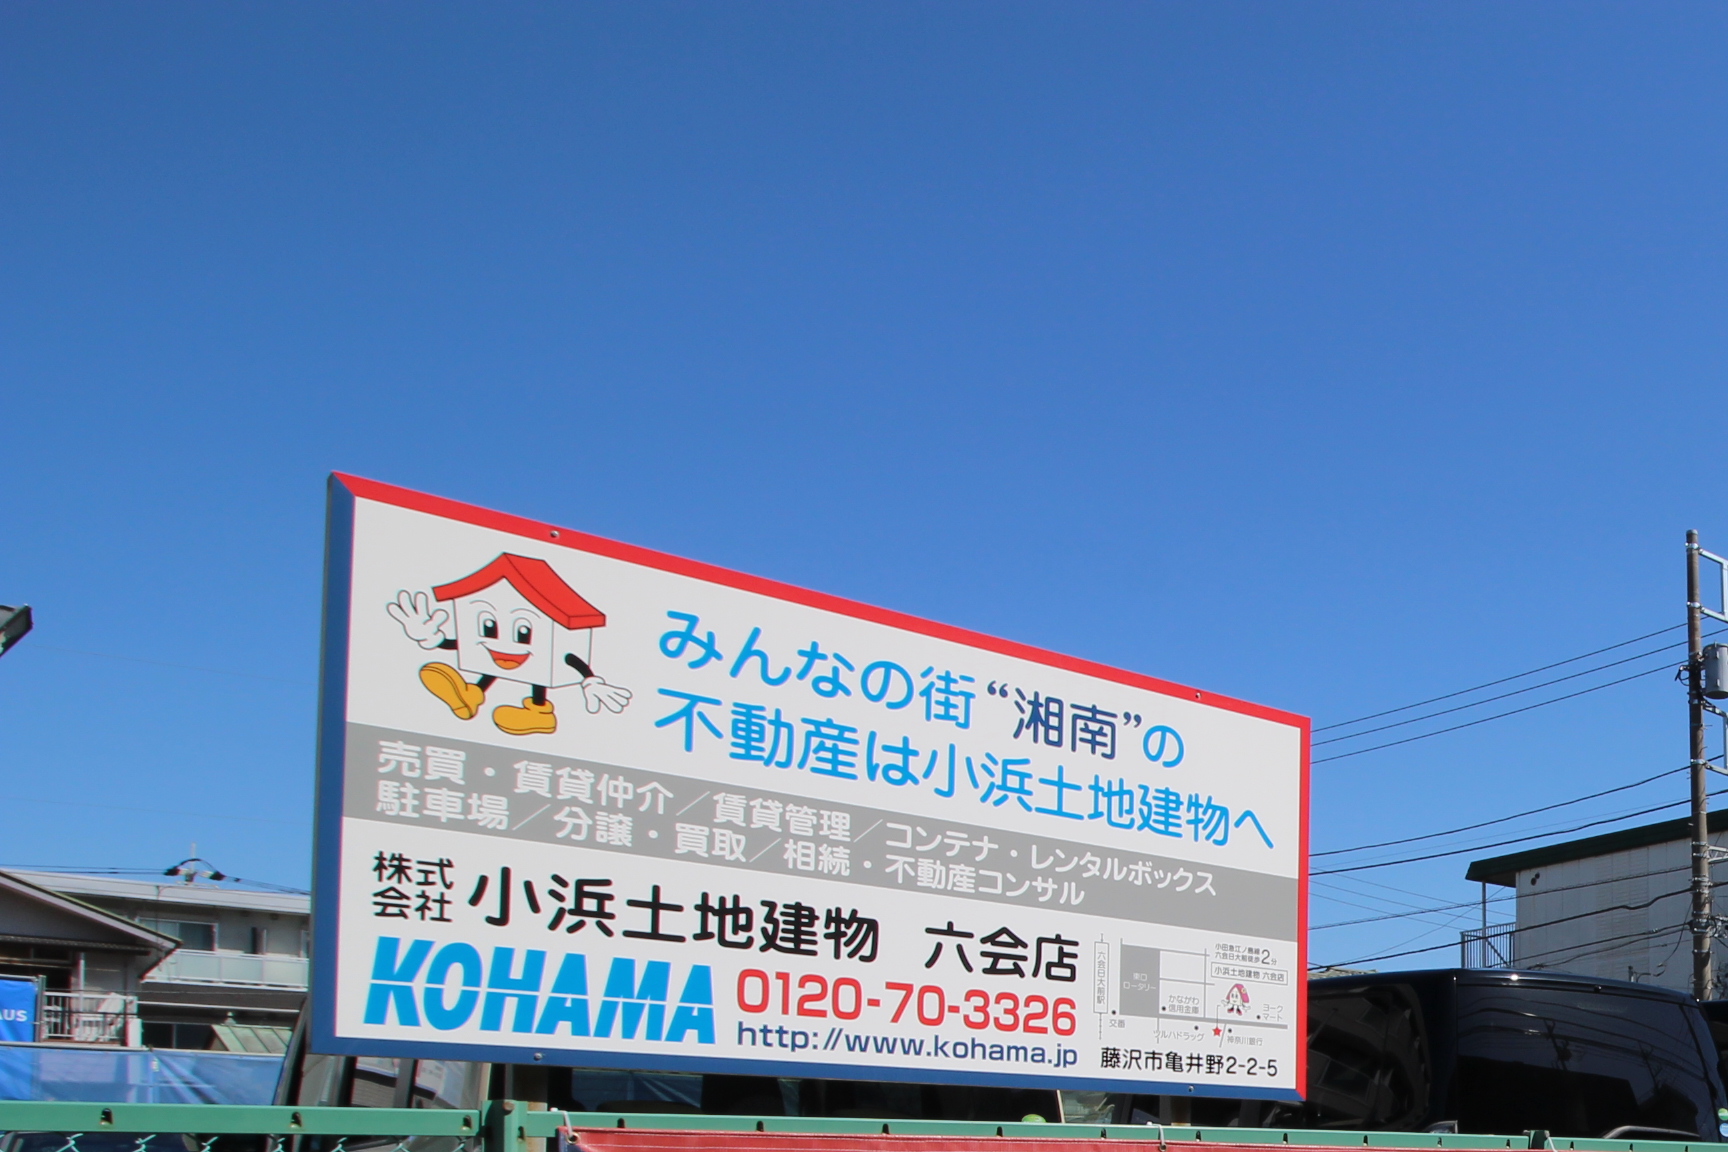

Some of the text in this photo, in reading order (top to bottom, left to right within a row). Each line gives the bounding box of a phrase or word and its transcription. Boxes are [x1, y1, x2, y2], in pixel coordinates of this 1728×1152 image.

[658, 609, 1185, 768] みんなの街“湘南”の
[654, 687, 1274, 849] 不動産は小浜土地建物へ
[372, 850, 455, 891] 株式
[372, 886, 453, 924] 会社
[468, 865, 1080, 982] 小浜土地建物 六会店
[363, 936, 717, 1045] KOHAMA
[1214, 966, 1285, 982] 小浜土地建物 六会店
[736, 968, 1078, 1037] 0120-70-3326
[1168, 994, 1200, 1006] かながわ
[1262, 1003, 1284, 1013] ヨーク
[1262, 1013, 1284, 1022] マート
[736, 1021, 1078, 1070] http://www.kohama.jp
[1100, 1046, 1278, 1077] 藤沢市亀井野2-2-5
